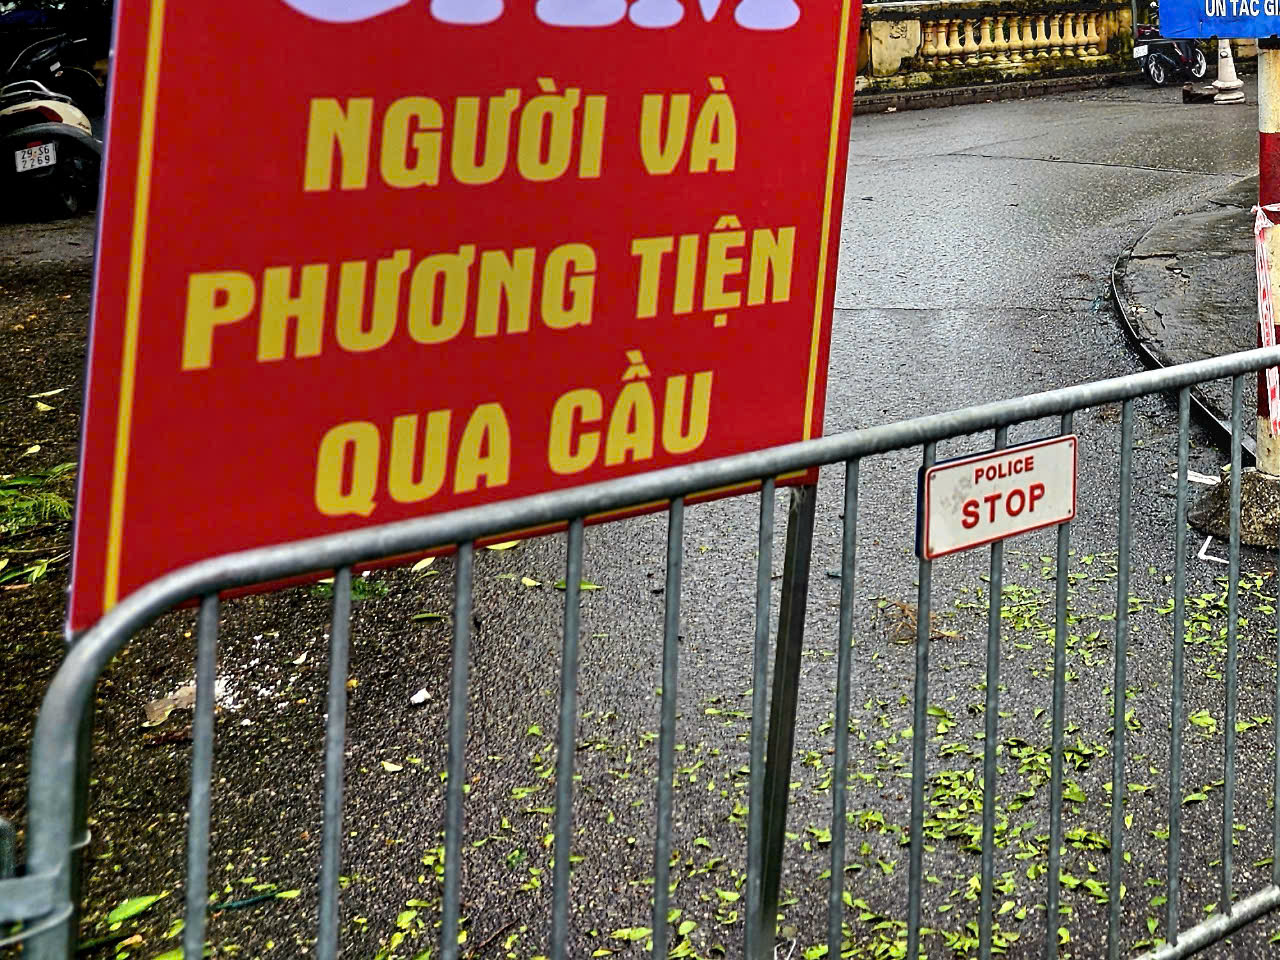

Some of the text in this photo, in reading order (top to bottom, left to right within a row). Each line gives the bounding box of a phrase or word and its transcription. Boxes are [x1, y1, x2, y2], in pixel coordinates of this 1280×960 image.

[303, 76, 738, 193] NGƯỜI VÀ
[181, 214, 797, 372] PHƯƠNG TIỆN
[314, 348, 714, 518] QUA CẦU
[975, 456, 1034, 485] POLICE
[961, 482, 1045, 529] STOP
